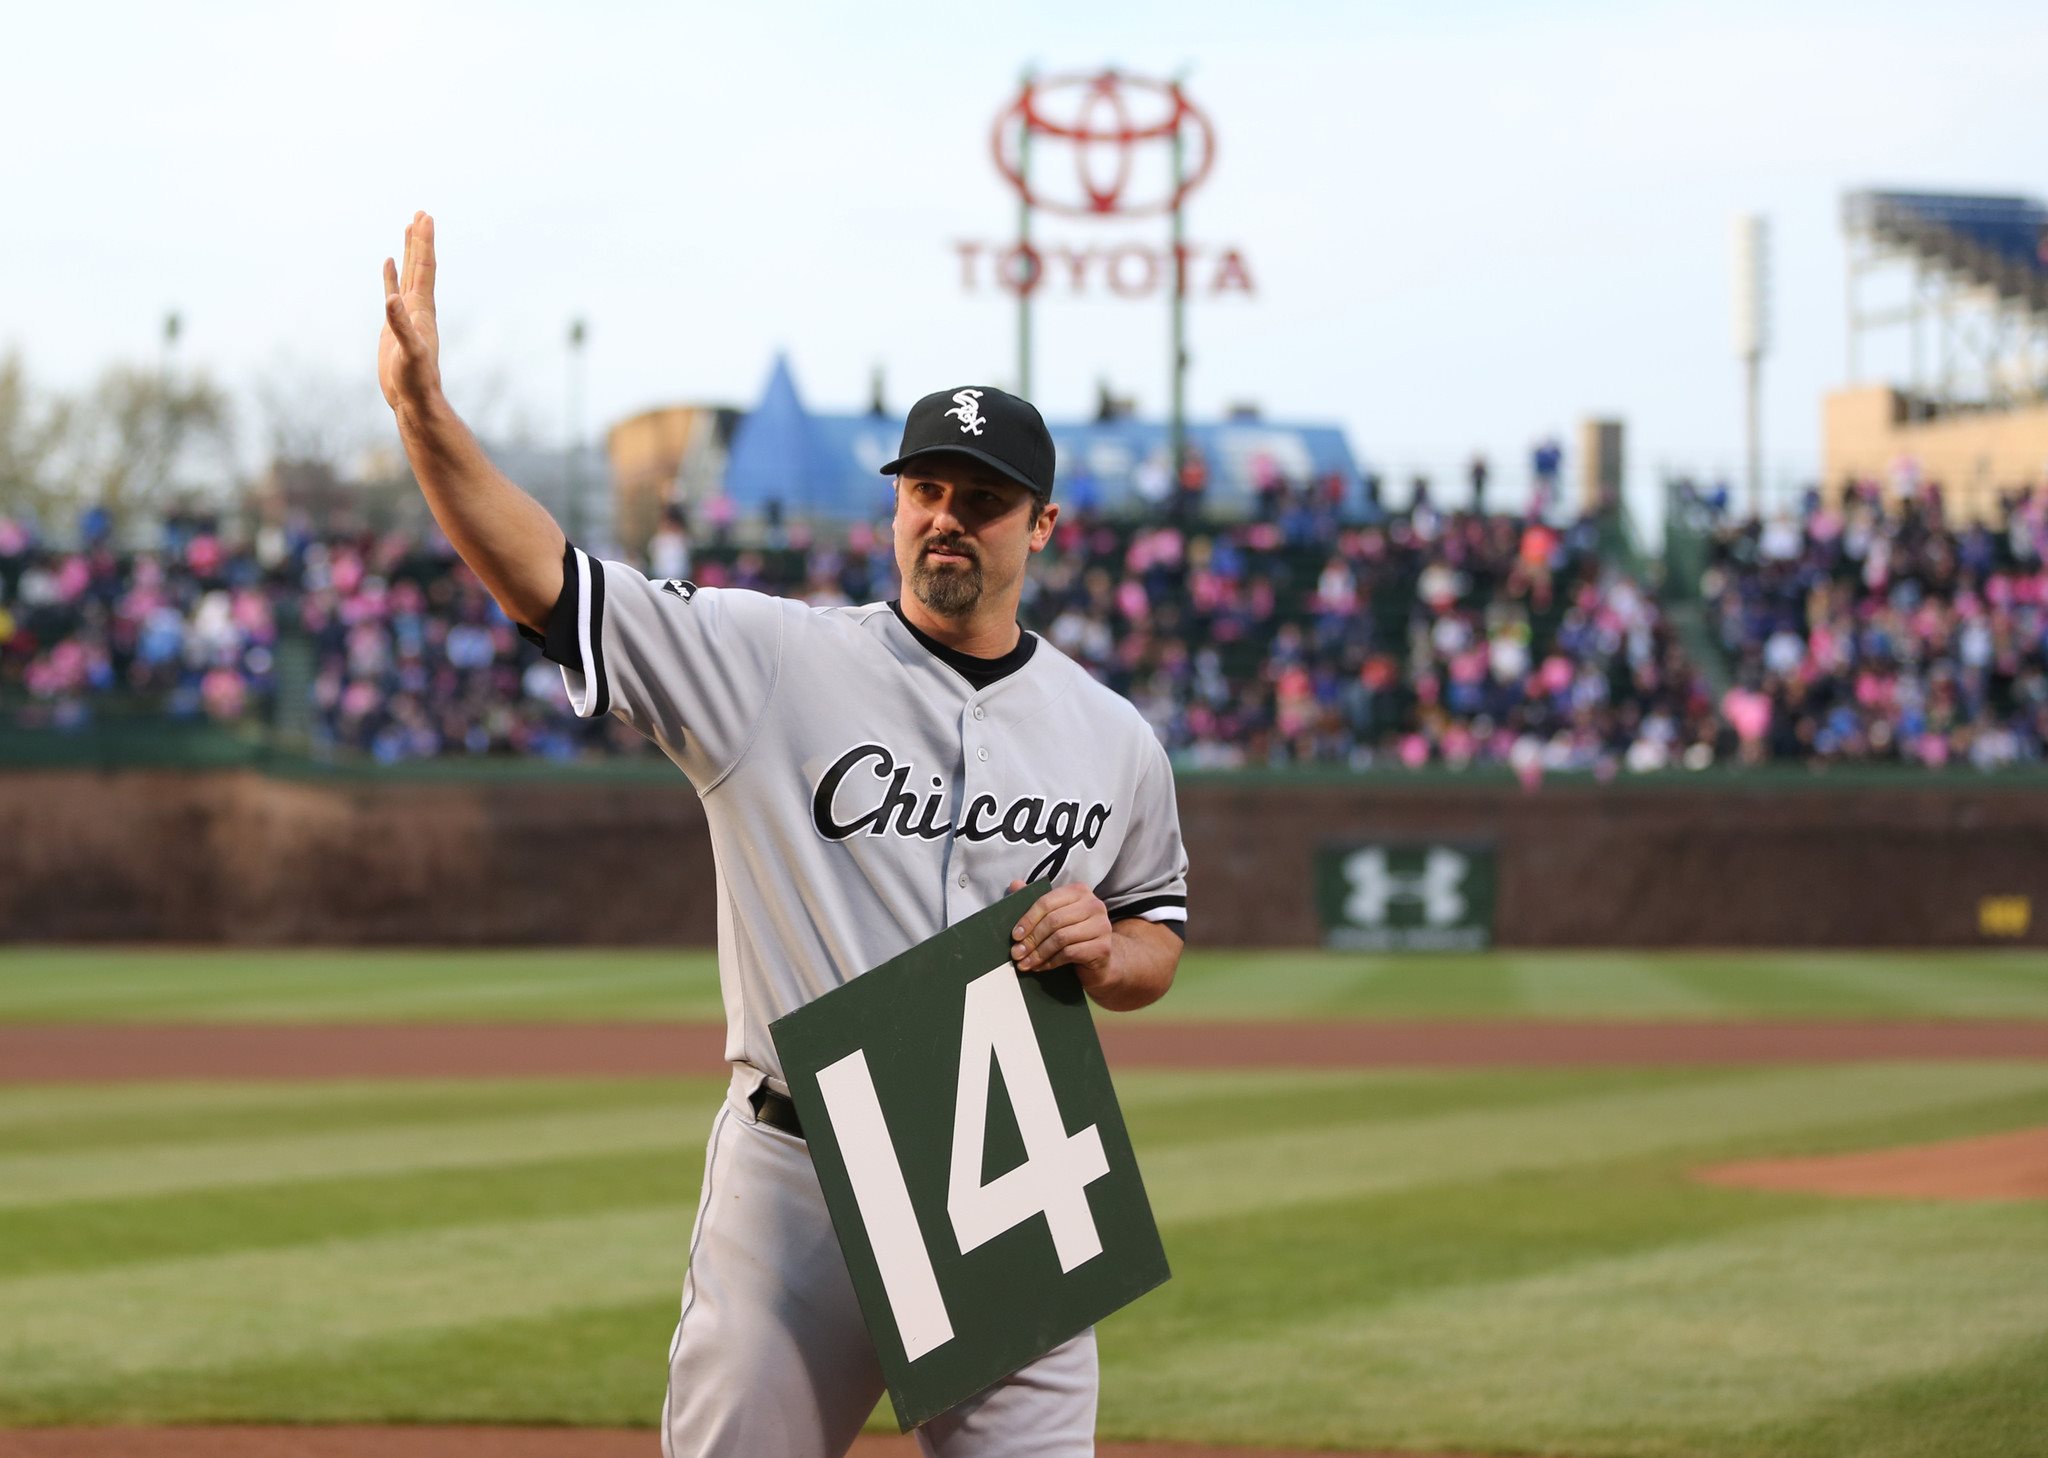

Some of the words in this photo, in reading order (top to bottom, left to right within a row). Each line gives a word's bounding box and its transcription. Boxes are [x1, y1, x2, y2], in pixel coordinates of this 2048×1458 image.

[955, 240, 1254, 299] TOYOTA
[810, 741, 1112, 885] Chicago
[816, 961, 1110, 1362] 14
